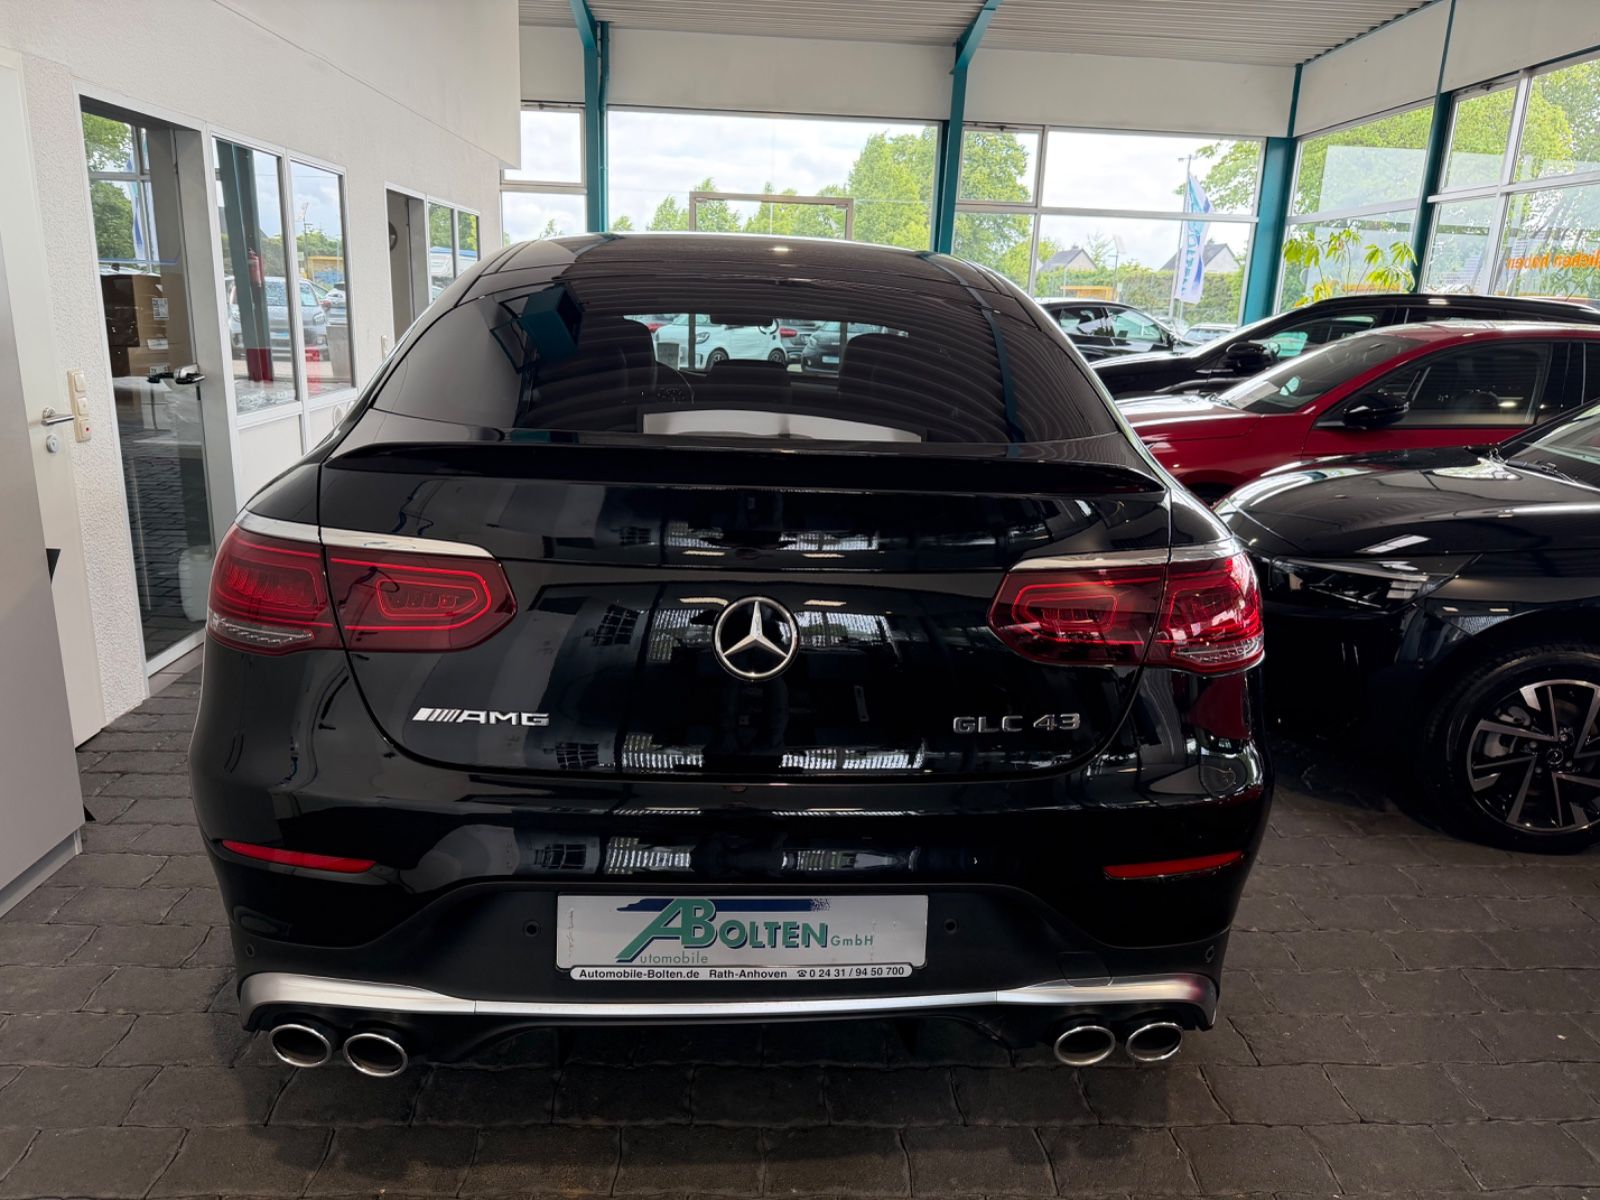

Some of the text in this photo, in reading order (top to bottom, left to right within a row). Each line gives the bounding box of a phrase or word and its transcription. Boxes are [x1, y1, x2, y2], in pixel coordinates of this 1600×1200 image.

[456, 710, 549, 727] AMG
[953, 713, 1080, 733] GLC 43
[831, 935, 874, 946] GmbH
[579, 969, 700, 979] Automobile-Bolten.de
[709, 969, 787, 978] Rath-Anhoven
[819, 969, 831, 977] 24
[834, 968, 845, 977] 31
[855, 968, 868, 976] 94
[871, 967, 883, 976] 50
[886, 967, 905, 975] 700
